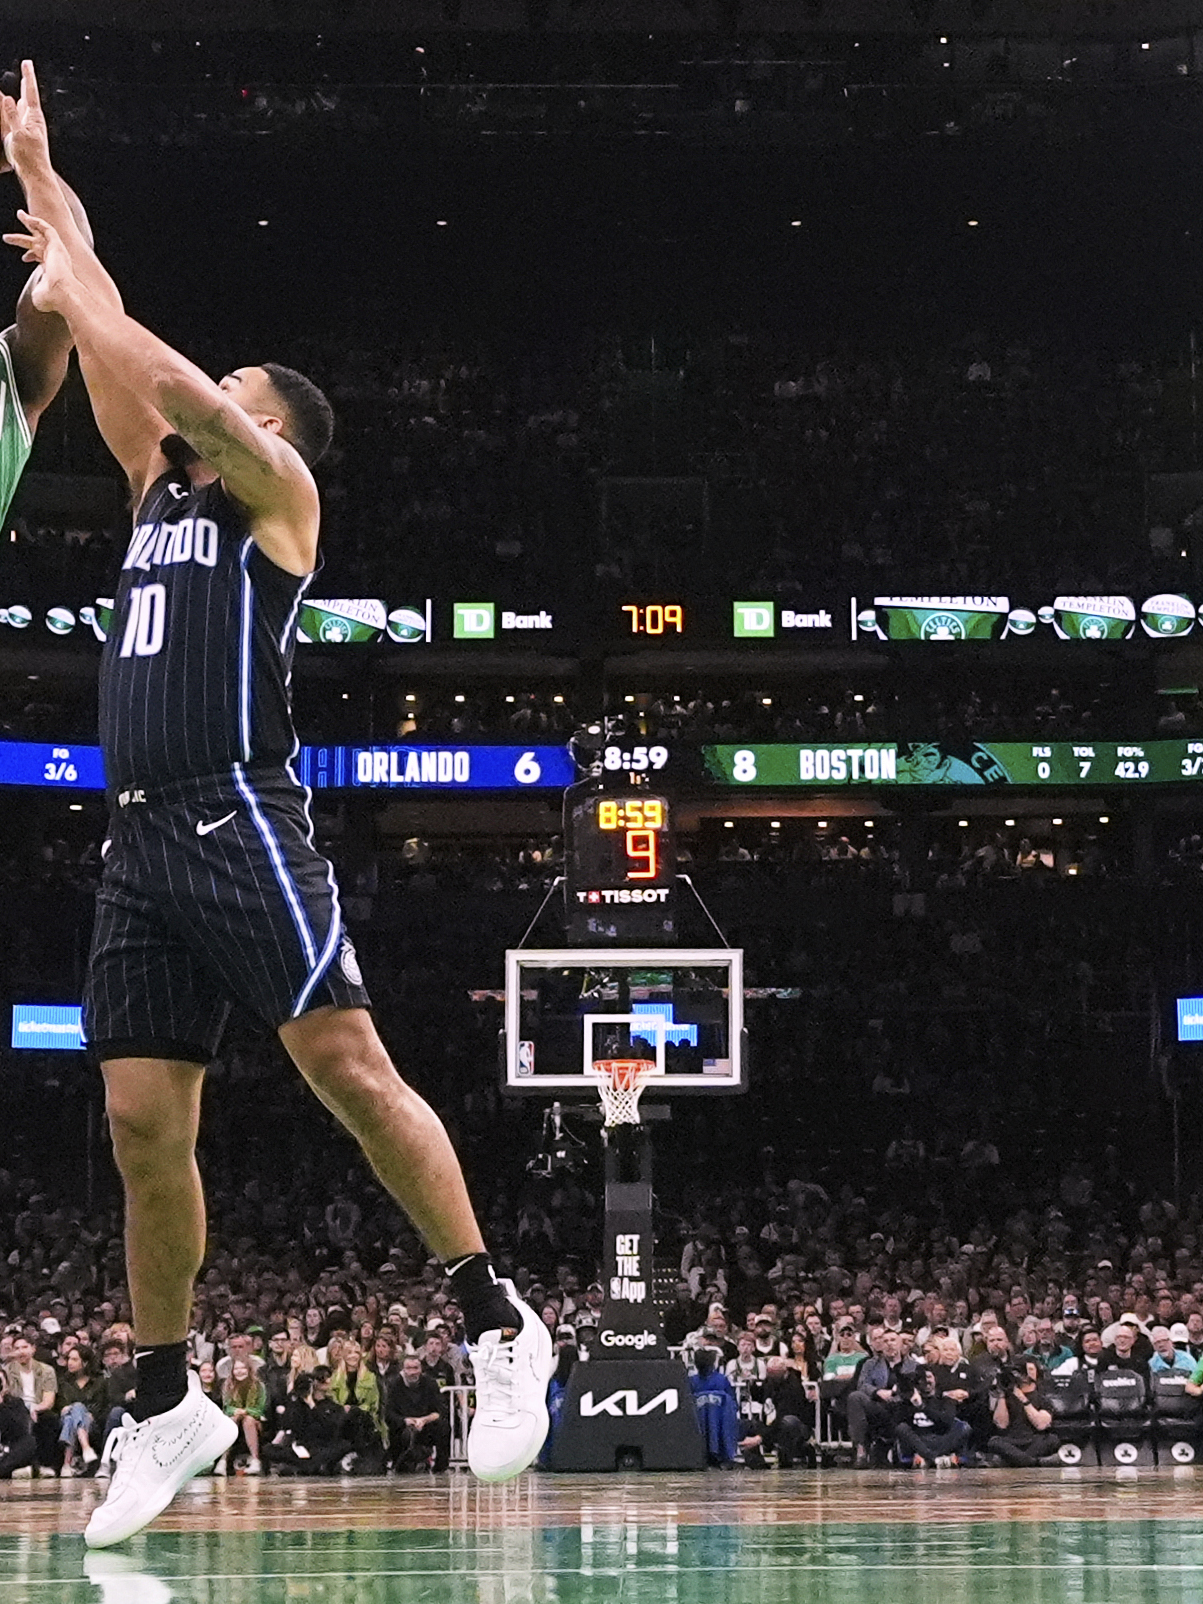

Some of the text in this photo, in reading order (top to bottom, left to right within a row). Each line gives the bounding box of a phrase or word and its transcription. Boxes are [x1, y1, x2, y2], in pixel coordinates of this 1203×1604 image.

[621, 604, 683, 634] 7:09
[736, 608, 832, 631] TD Bank
[1061, 601, 1129, 617] TEMPLETON
[119, 583, 166, 658] 10
[457, 609, 553, 632] TD Bank
[604, 745, 669, 770] 8:59
[1032, 746, 1051, 757] FLS
[1116, 746, 1144, 757] FG%
[44, 762, 77, 781] 3/6
[357, 751, 470, 782] ORLANDO
[514, 752, 541, 784] 6
[733, 749, 757, 782] 8
[799, 749, 896, 780] BOSTON
[1037, 761, 1051, 778] 0
[1079, 761, 1091, 778] 7
[1114, 761, 1149, 778] 42.9
[1182, 757, 1203, 775] 3/
[599, 800, 662, 830] 8:59
[626, 830, 657, 879] 9
[601, 888, 669, 904] TISSOT
[616, 1234, 640, 1255] GET
[616, 1256, 640, 1276] THE
[621, 1277, 646, 1303] App
[600, 1329, 657, 1350] Google
